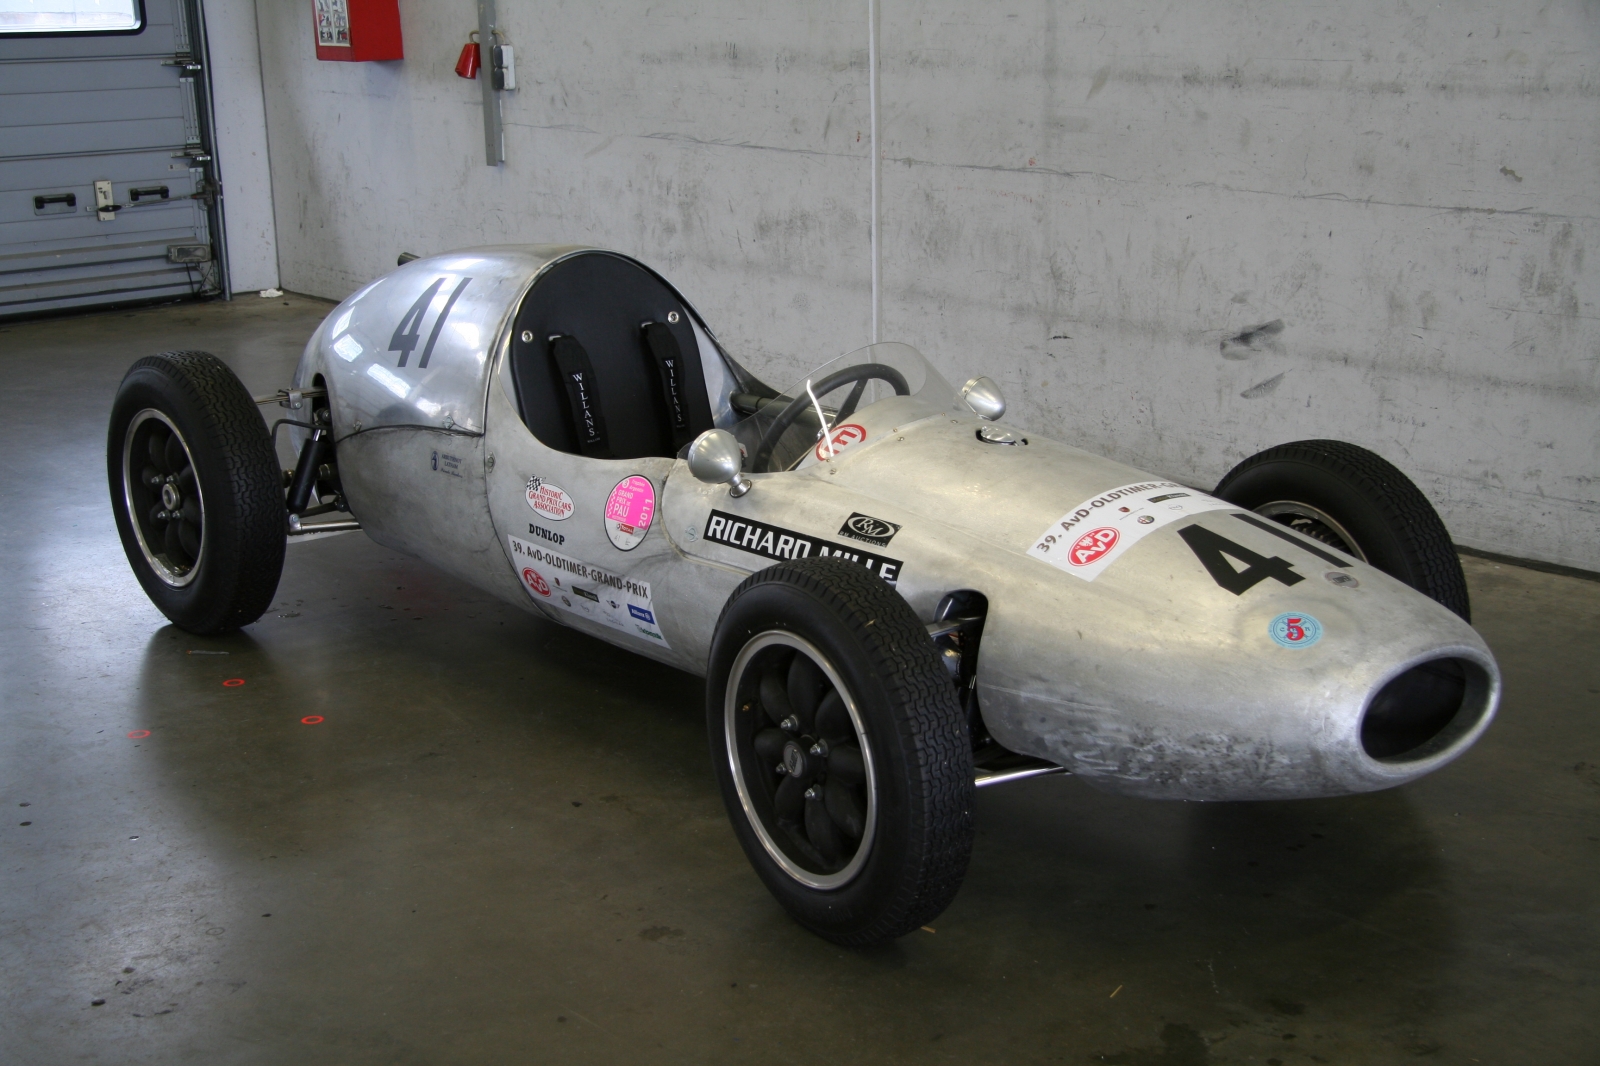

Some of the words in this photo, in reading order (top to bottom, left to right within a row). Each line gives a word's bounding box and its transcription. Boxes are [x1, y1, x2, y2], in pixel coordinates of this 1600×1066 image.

[388, 277, 473, 369] 41
[665, 359, 682, 422] WILLANS
[572, 372, 596, 437] WILLANS
[528, 490, 546, 502] GRAND
[539, 485, 563, 501] HISTORIC
[616, 496, 627, 505] PRIX
[618, 489, 634, 499] GRAND
[533, 500, 565, 518] ASSOCIATION
[613, 503, 630, 518] PAU
[638, 499, 653, 528] 2011
[528, 523, 565, 545] DUNLOP
[707, 515, 812, 560] RICHARD
[850, 534, 887, 548] AUCTIONS
[1036, 534, 1063, 553] 39.
[1075, 529, 1116, 564] AvD
[1176, 513, 1354, 597] 41
[512, 540, 526, 555] 39.
[526, 545, 649, 599] AvD-OLDTIMER-GRAND-PRIX
[1286, 617, 1304, 641] 5
